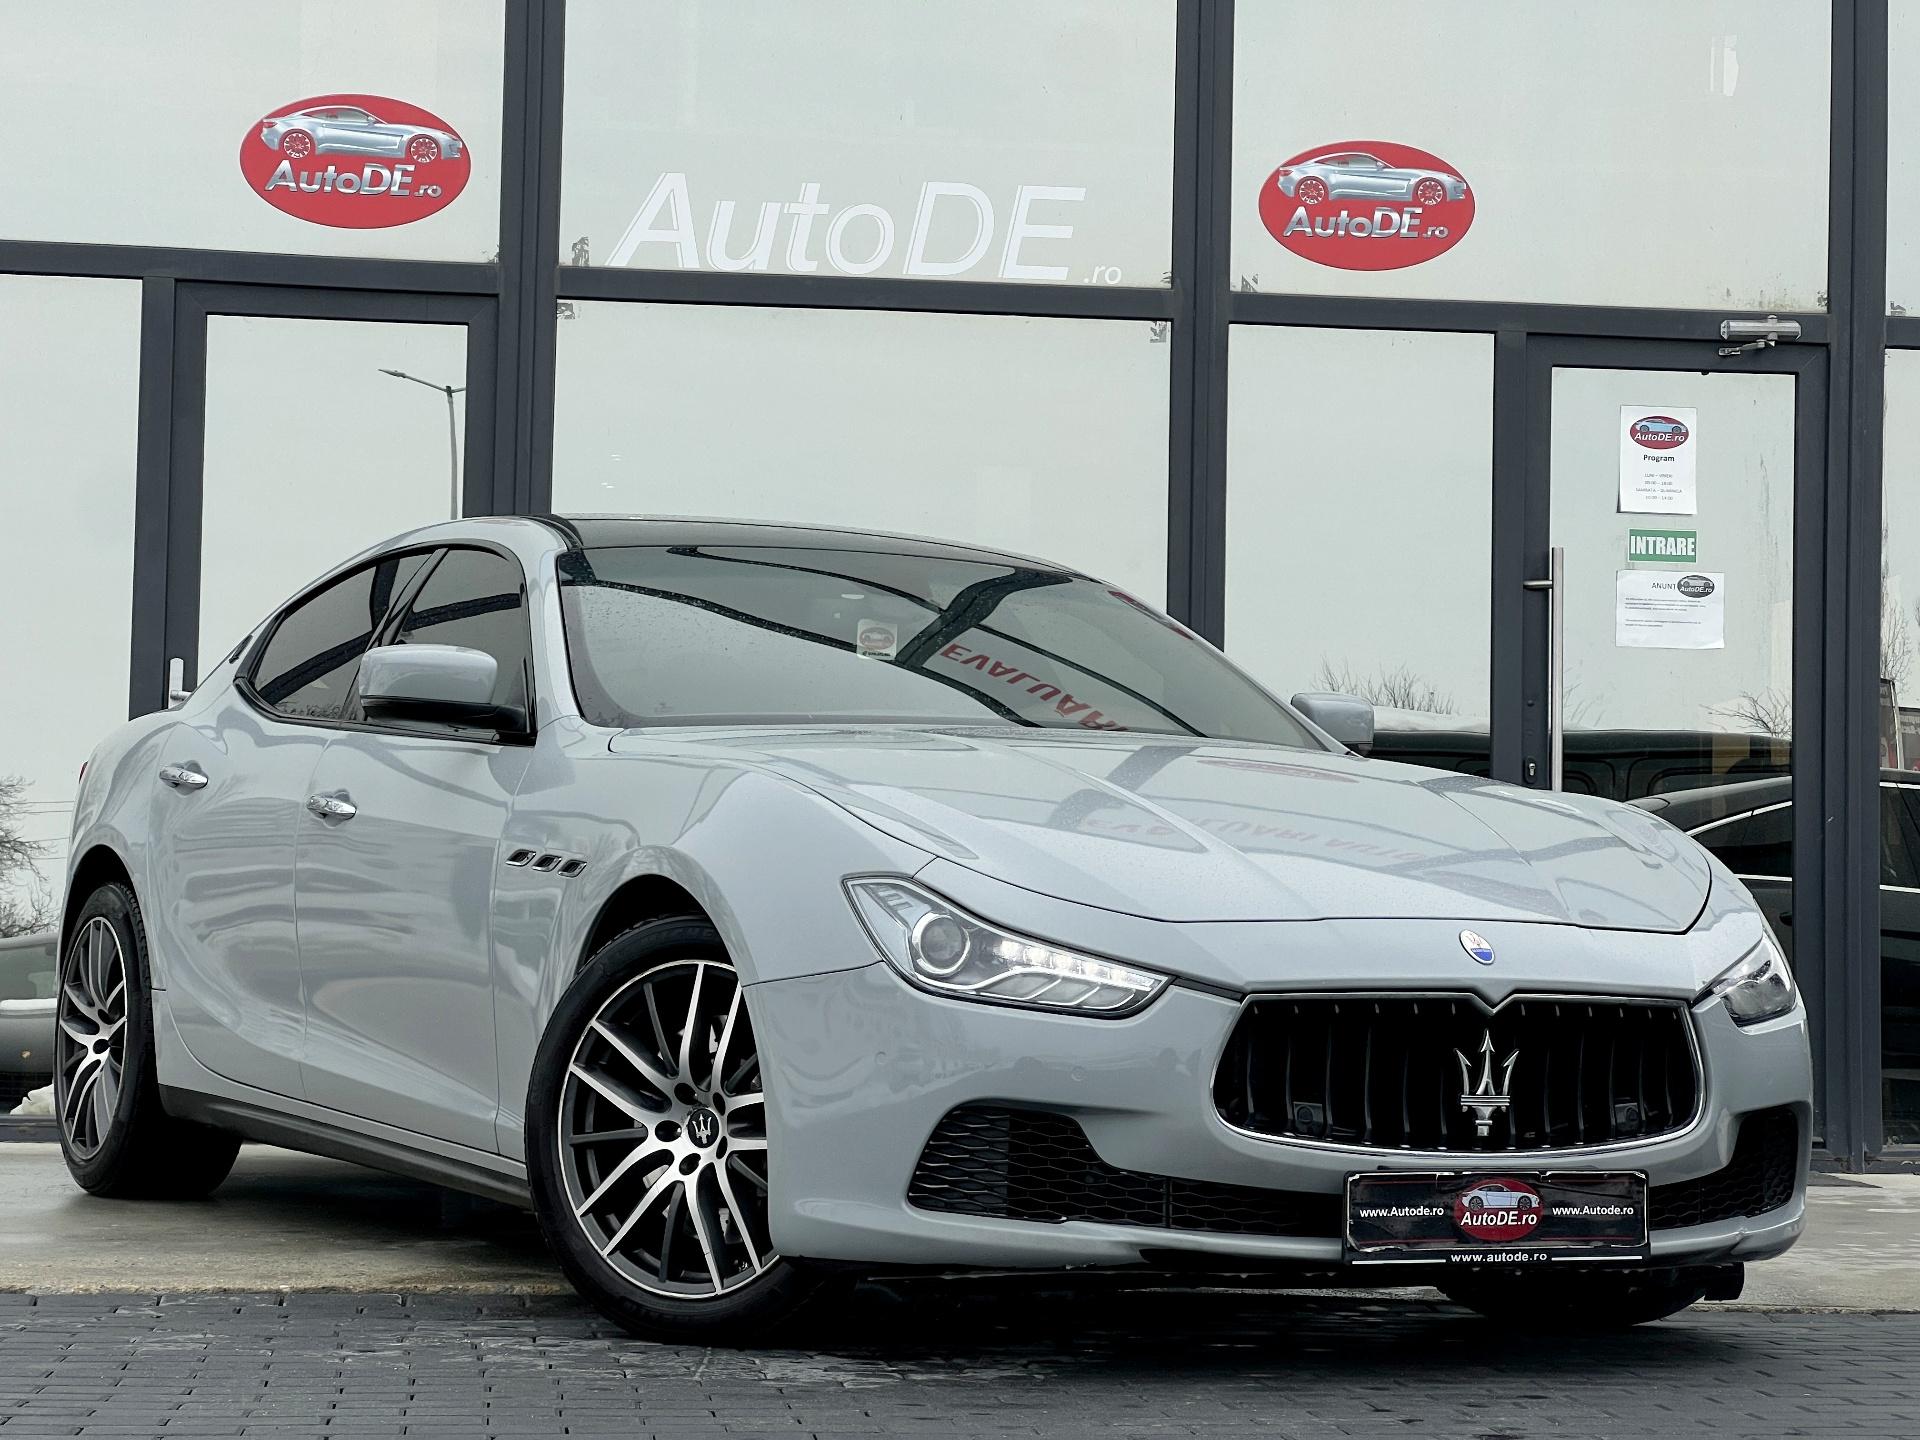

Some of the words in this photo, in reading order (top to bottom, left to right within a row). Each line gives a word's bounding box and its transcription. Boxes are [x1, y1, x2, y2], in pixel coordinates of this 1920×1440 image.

[1634, 432, 1685, 442] AutoDE.ro
[1643, 454, 1675, 463] Program
[1630, 535, 1695, 556] INTRARE
[1359, 1205, 1444, 1218] www.Autode.ro
[1552, 1205, 1634, 1216] www.Autode.ro
[1460, 1210, 1538, 1227] AutoDE.ro
[1450, 1251, 1548, 1263] www.autode.ro
